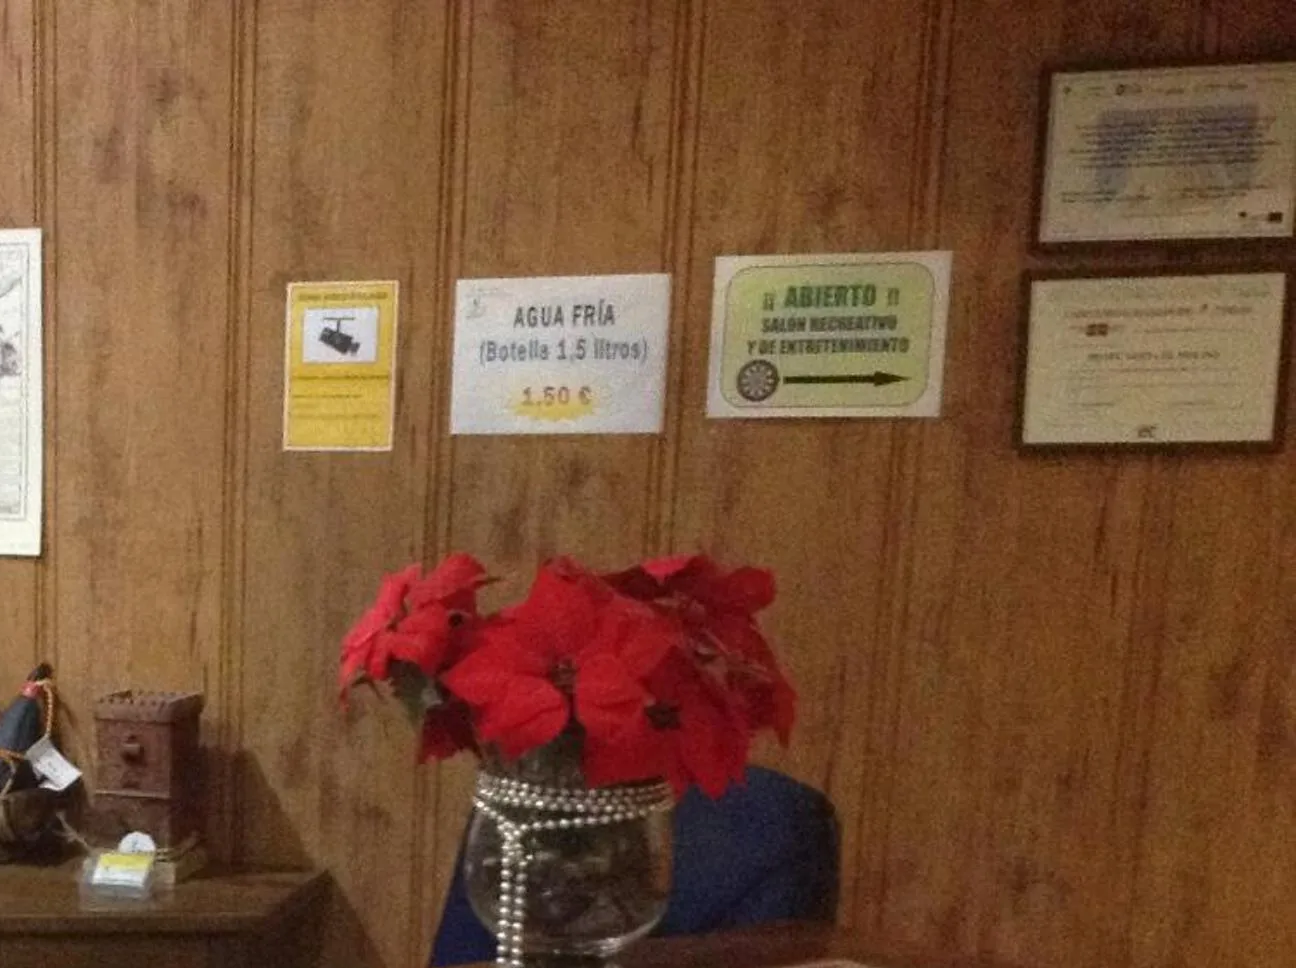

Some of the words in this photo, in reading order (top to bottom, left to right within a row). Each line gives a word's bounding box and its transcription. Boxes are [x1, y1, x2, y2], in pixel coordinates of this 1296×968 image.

[784, 284, 876, 308] ABIERTO
[513, 305, 565, 329] AGUA
[572, 299, 616, 327] FRÍA
[809, 314, 897, 332] RECREATIVO
[479, 338, 549, 369] (Botella
[593, 336, 648, 366] litros)
[747, 339, 757, 355] Y
[758, 338, 776, 355] DE
